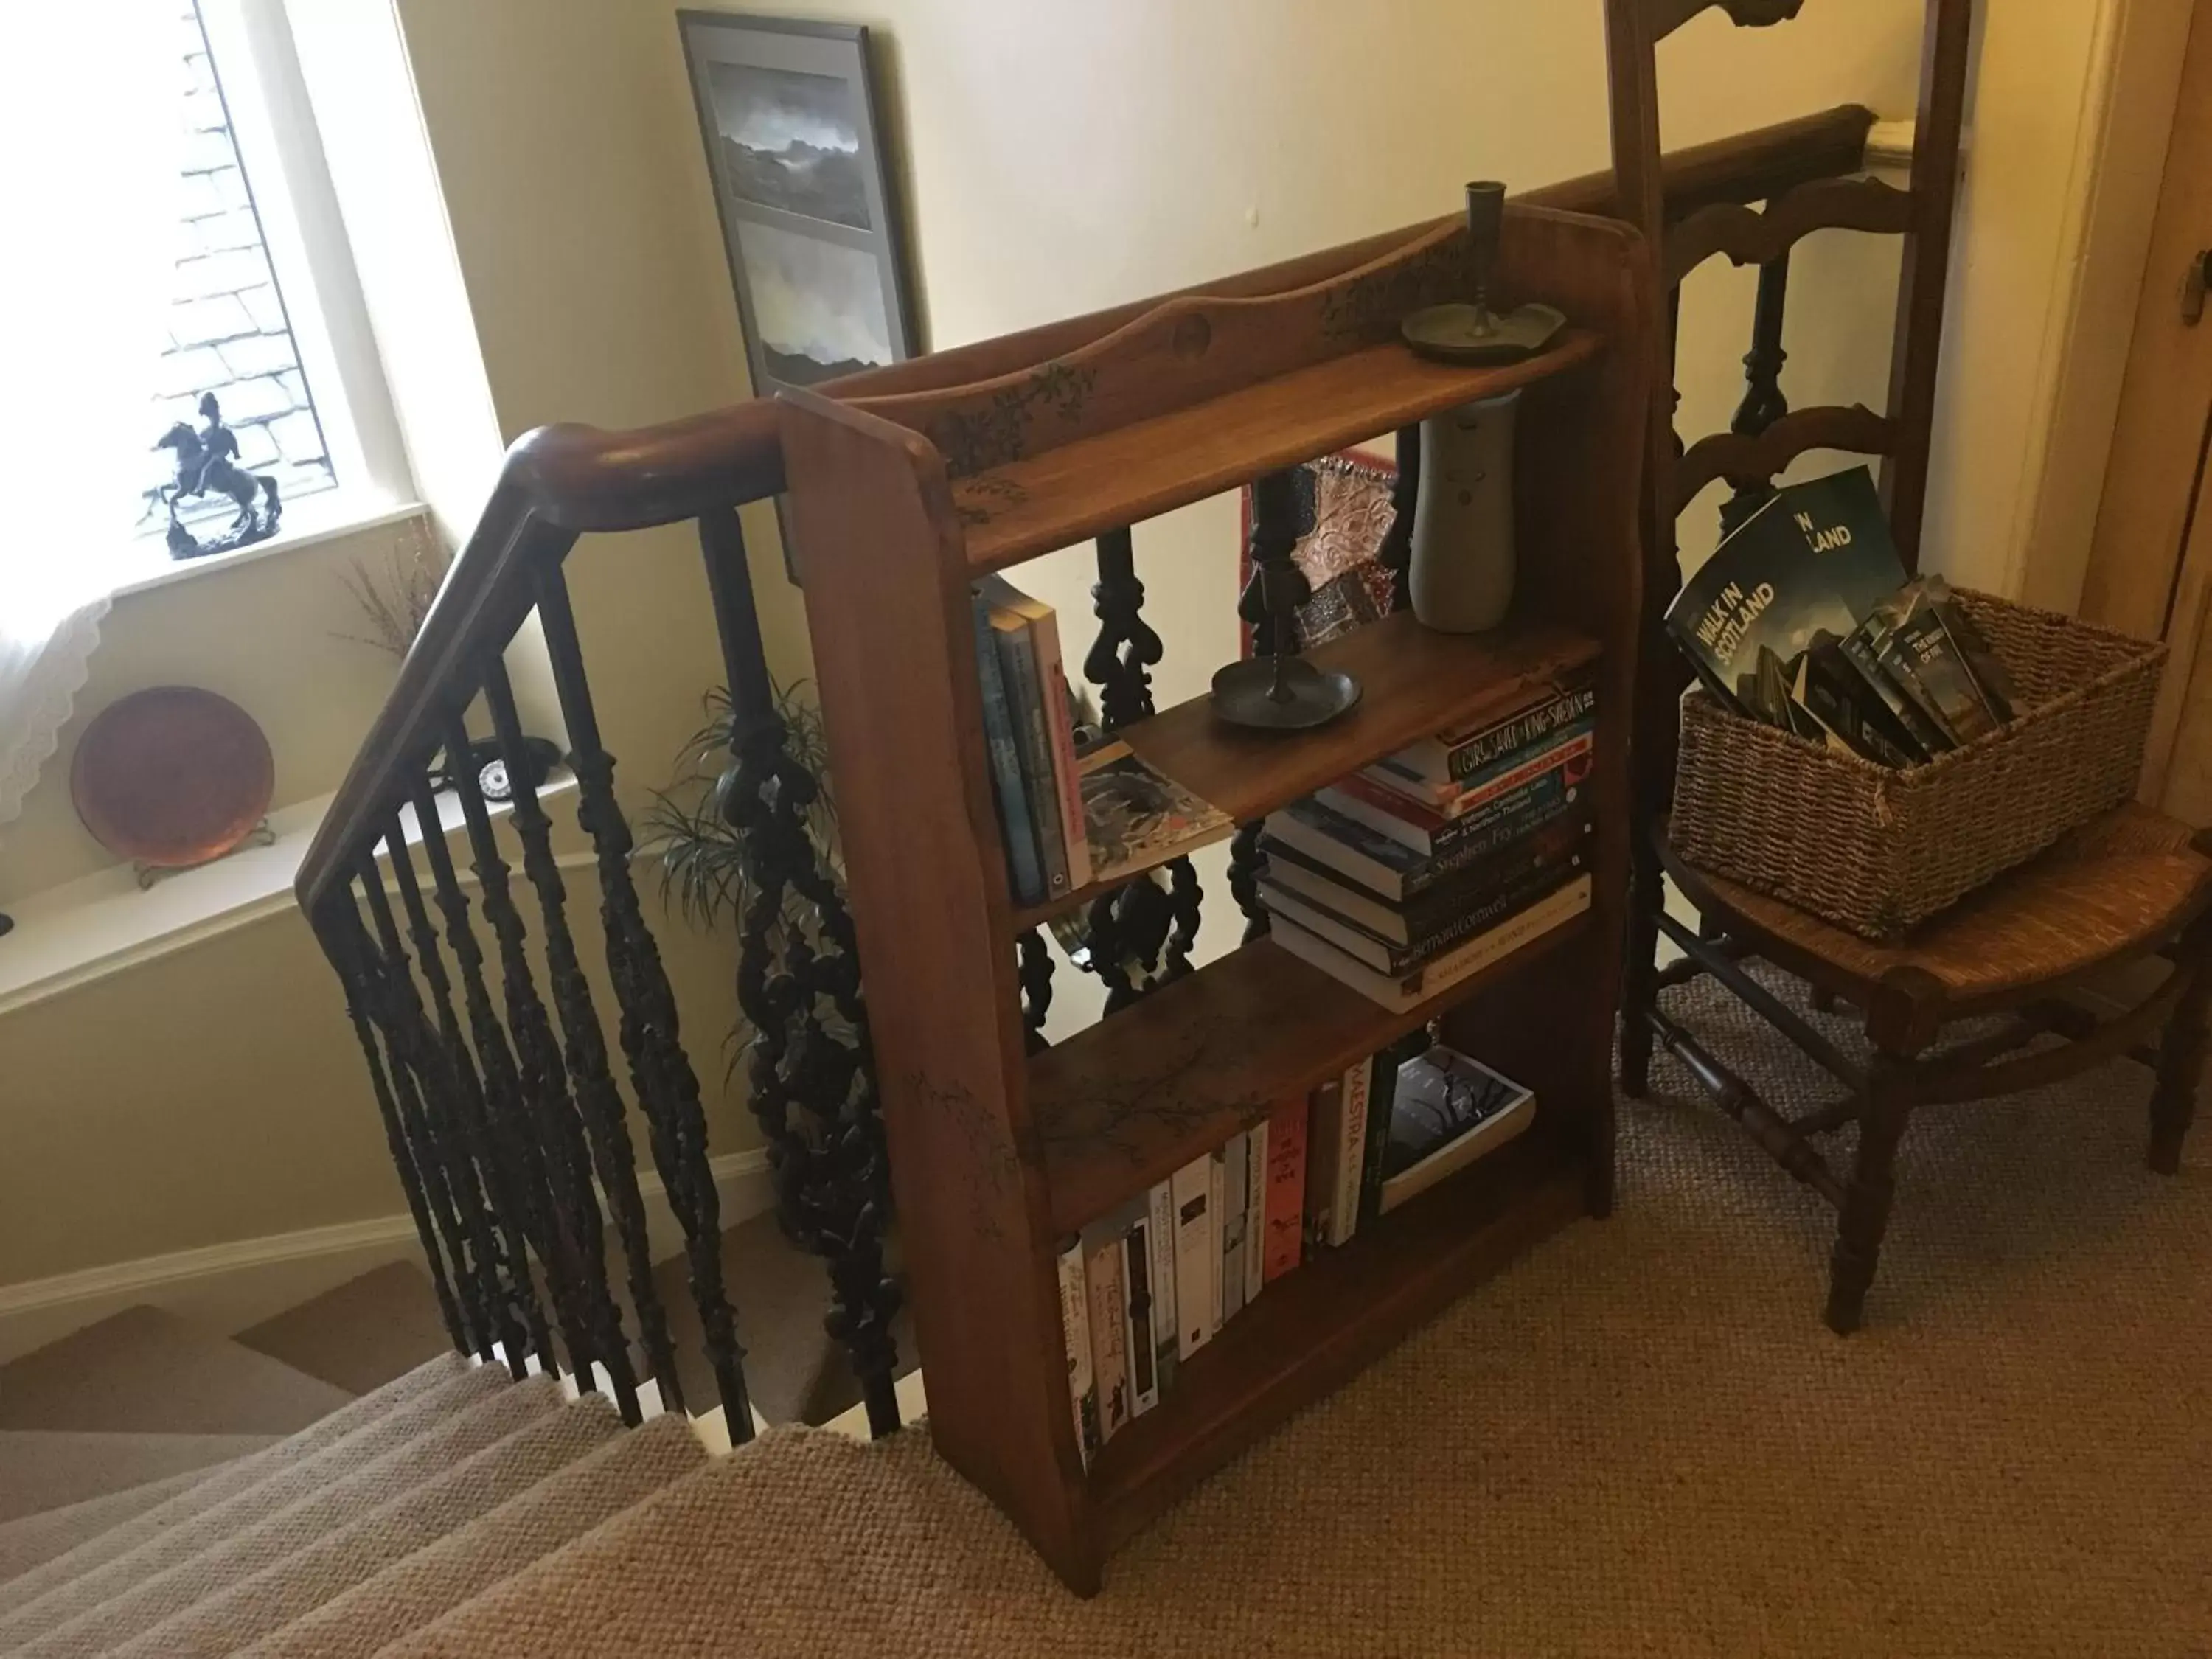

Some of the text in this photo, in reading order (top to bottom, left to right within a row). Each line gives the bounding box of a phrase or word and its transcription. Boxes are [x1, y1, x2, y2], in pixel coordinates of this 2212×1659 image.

[1696, 582, 1744, 647] WALK IN
[1714, 582, 1775, 667] SCOTLAND
[1436, 840, 1487, 873] Stephen
[1348, 1064, 1366, 1152] MAESTRA
